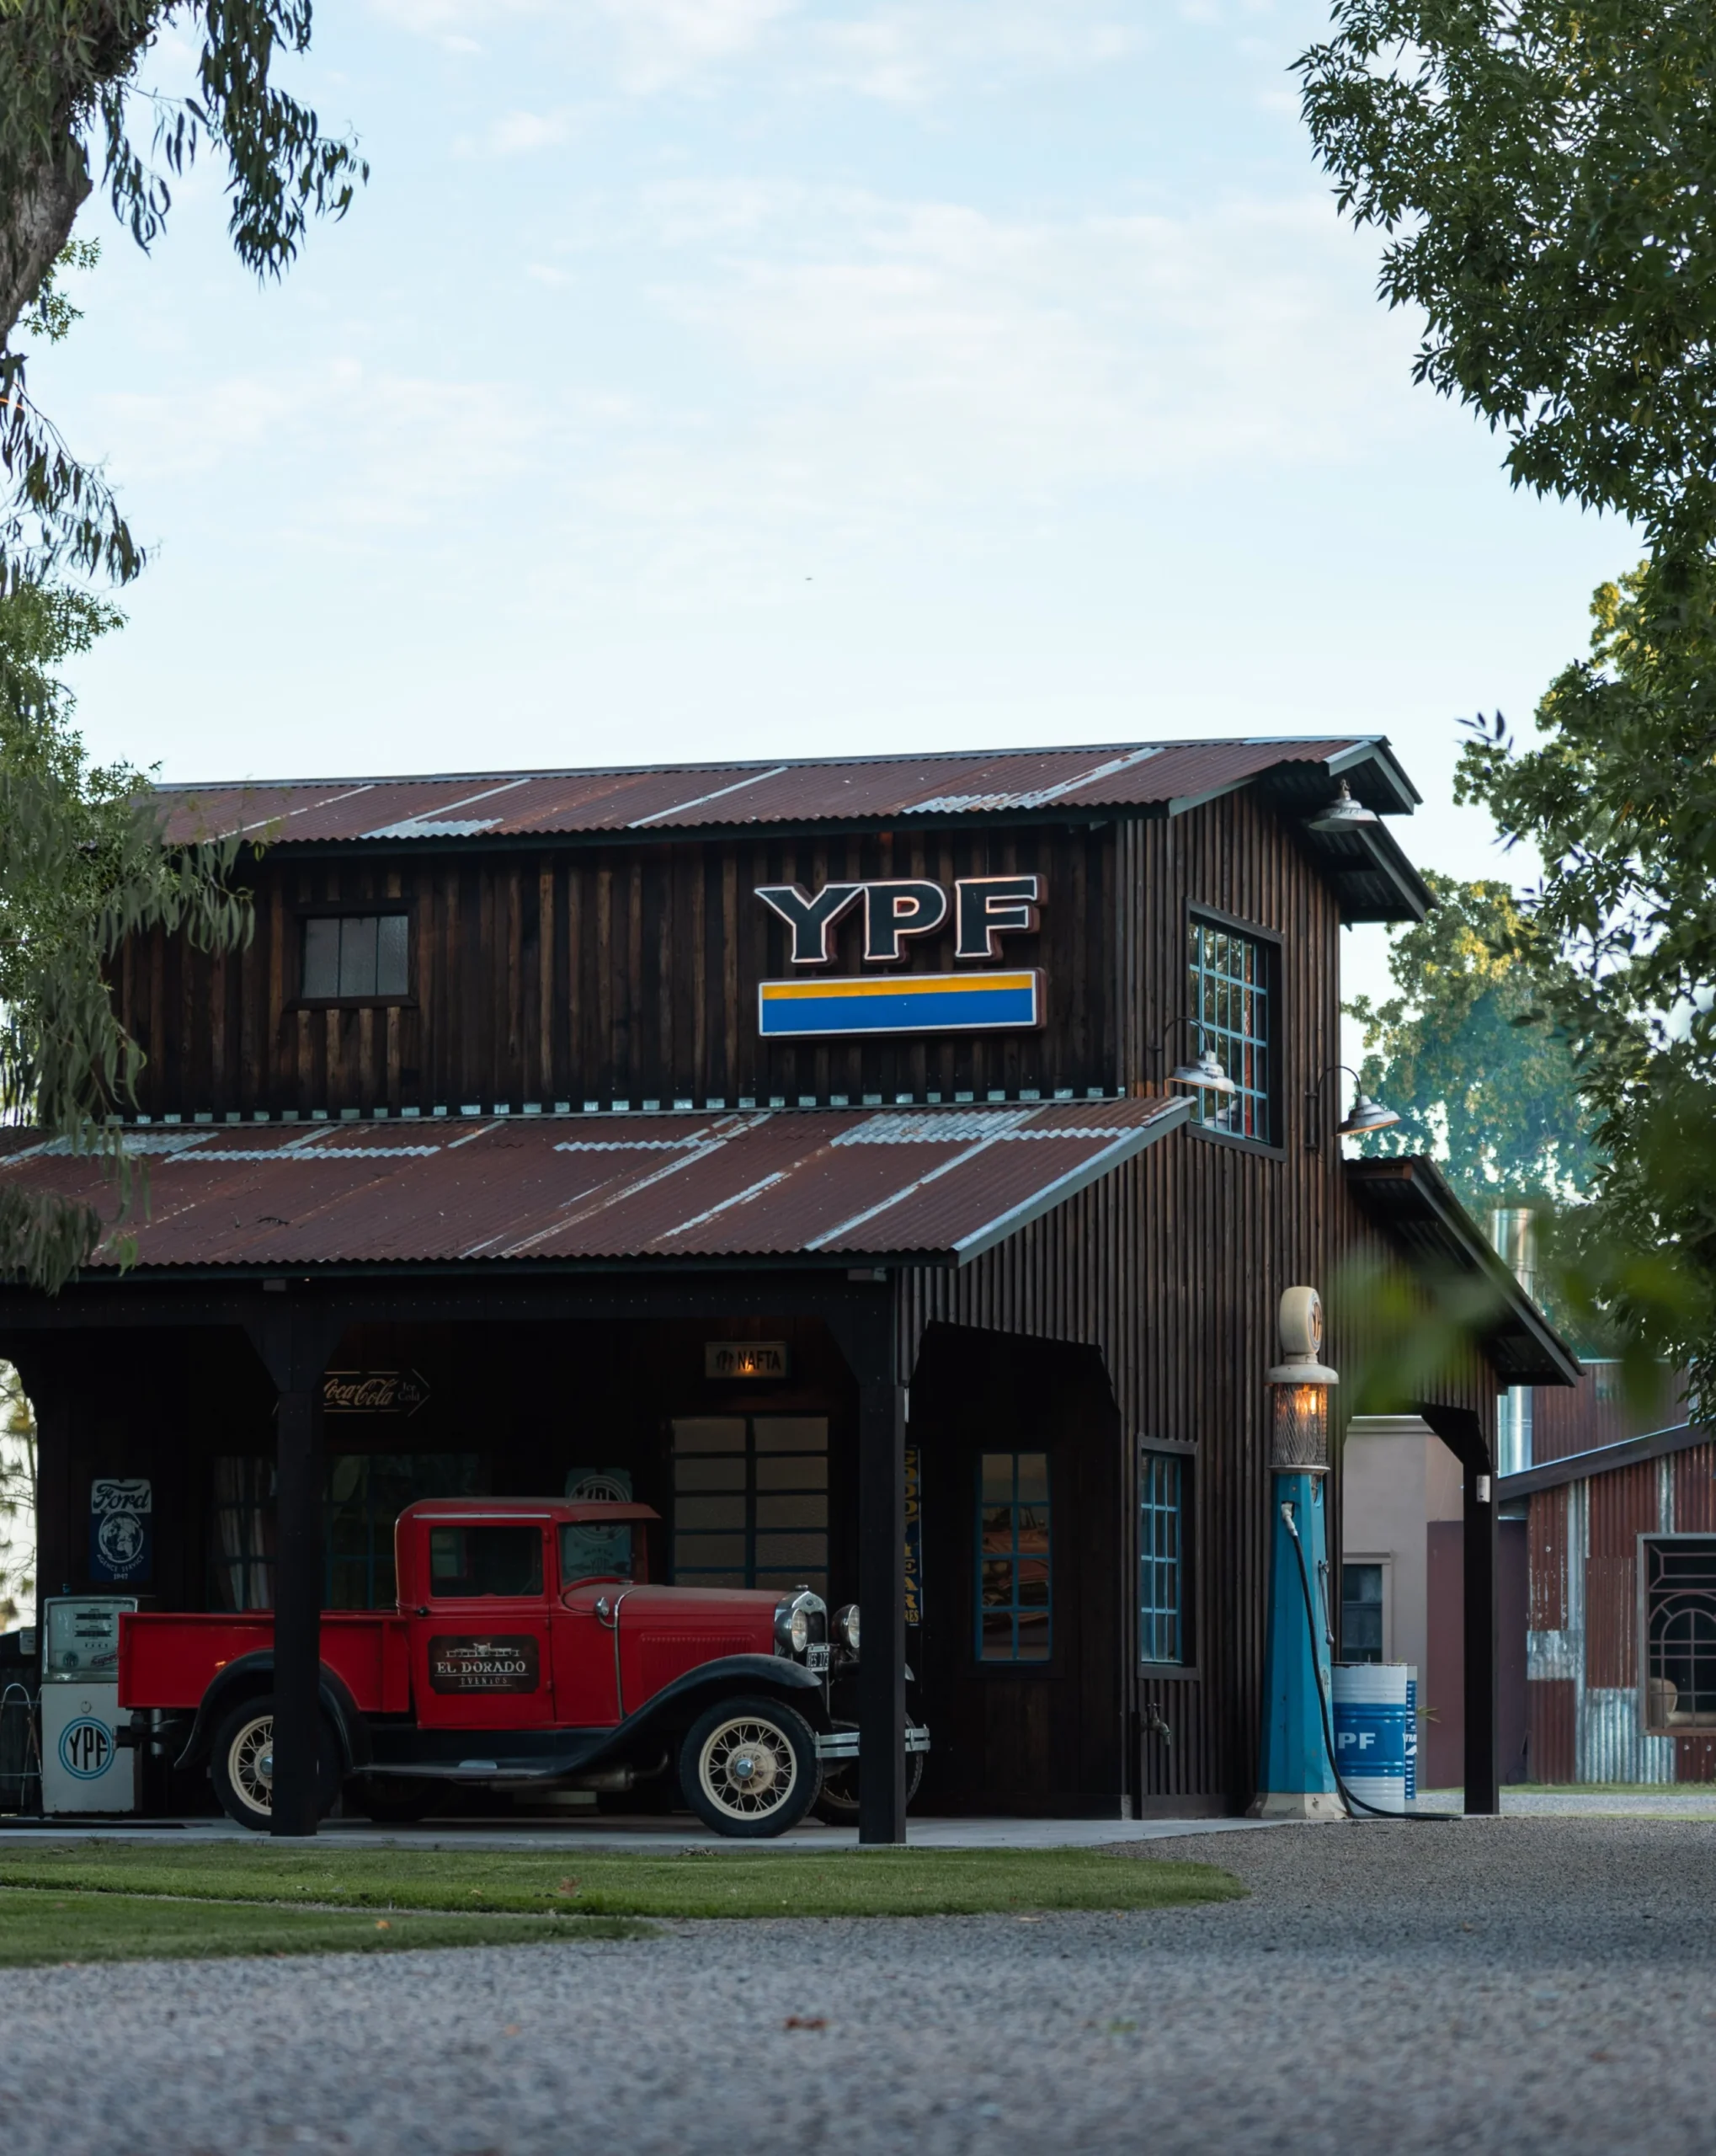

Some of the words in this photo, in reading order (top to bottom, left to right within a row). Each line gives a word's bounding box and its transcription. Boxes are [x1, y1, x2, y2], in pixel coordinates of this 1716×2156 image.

[754, 876, 1039, 963] YPF
[738, 1350, 781, 1370] NAFTA
[402, 1382, 417, 1391] Ice
[397, 1391, 420, 1401] Cold
[93, 1483, 150, 1509] Ford
[121, 1554, 145, 1572] SERVICE
[436, 1662, 456, 1673] EL
[461, 1660, 526, 1673] DORADO
[70, 1726, 108, 1770] YPF
[1338, 1732, 1376, 1749] PF
